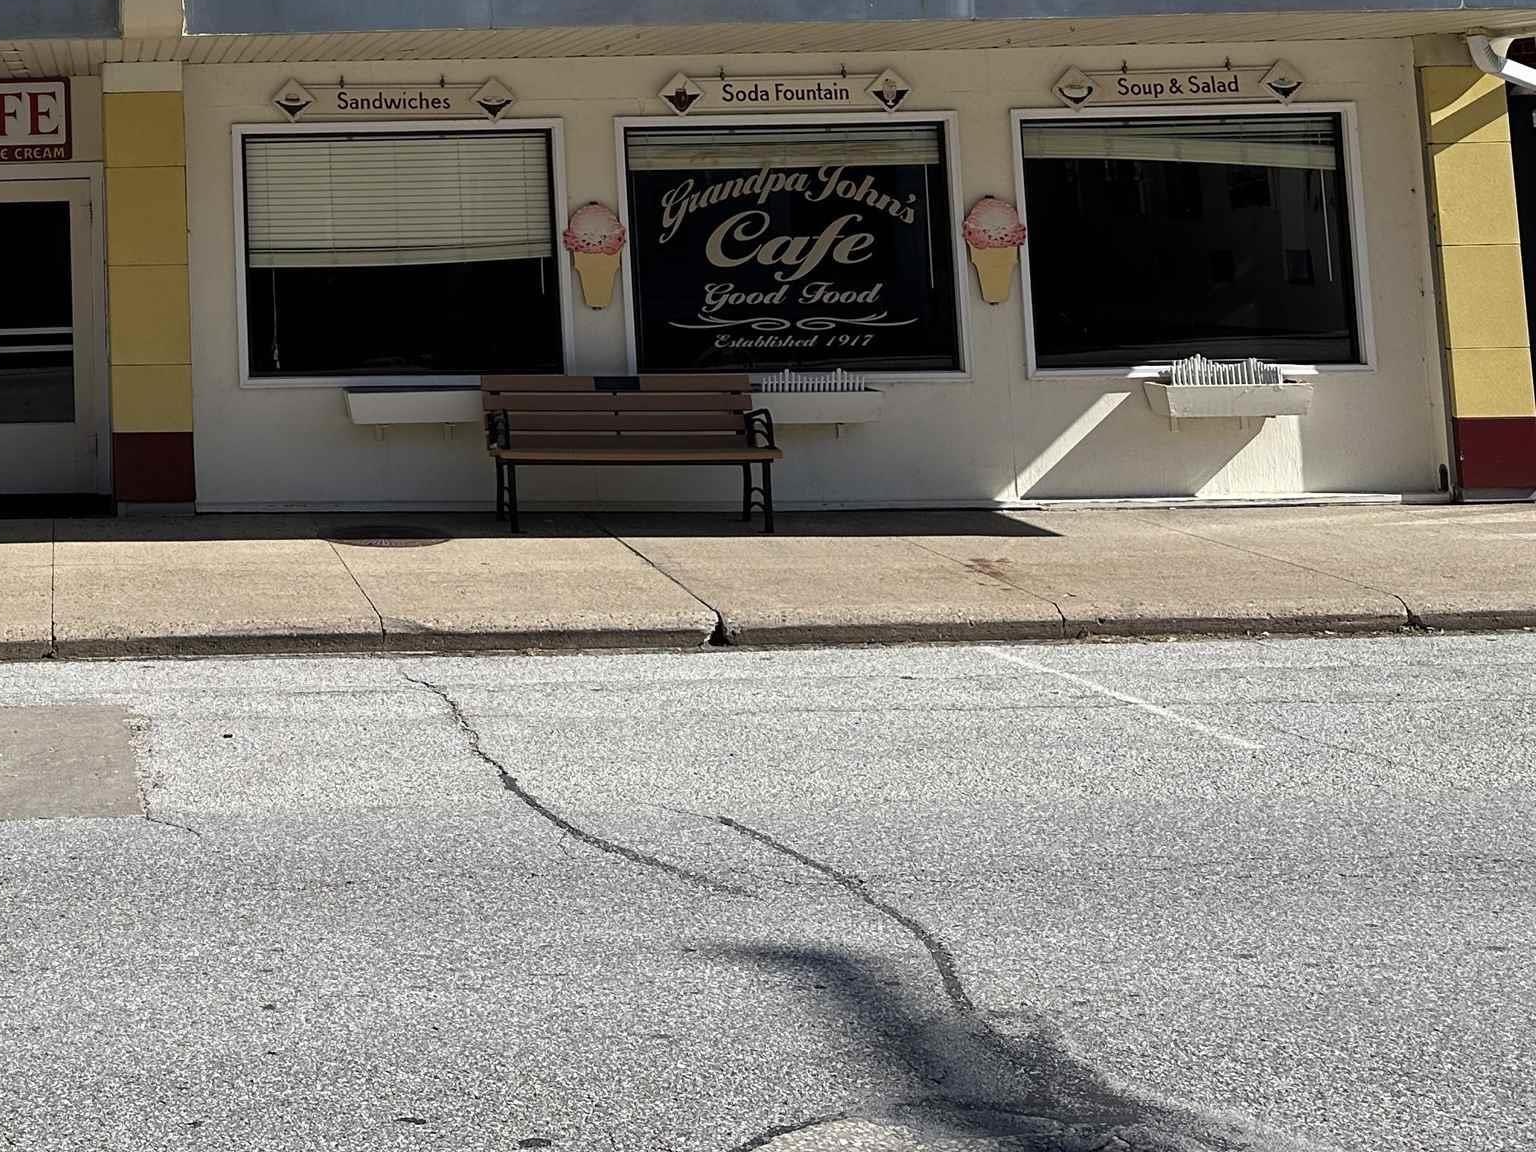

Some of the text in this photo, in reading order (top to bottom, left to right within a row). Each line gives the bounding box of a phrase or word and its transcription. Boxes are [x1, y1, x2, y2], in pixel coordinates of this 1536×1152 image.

[722, 82, 850, 102] Soda Fountain
[1117, 75, 1239, 98] Soup & Salad
[337, 91, 451, 110] Sandwiches
[14, 146, 66, 161] CREAM
[659, 165, 922, 244] Grandpa John's
[705, 210, 875, 282] Cafe
[702, 281, 884, 313] Good Food
[714, 334, 874, 349] Established 1917
